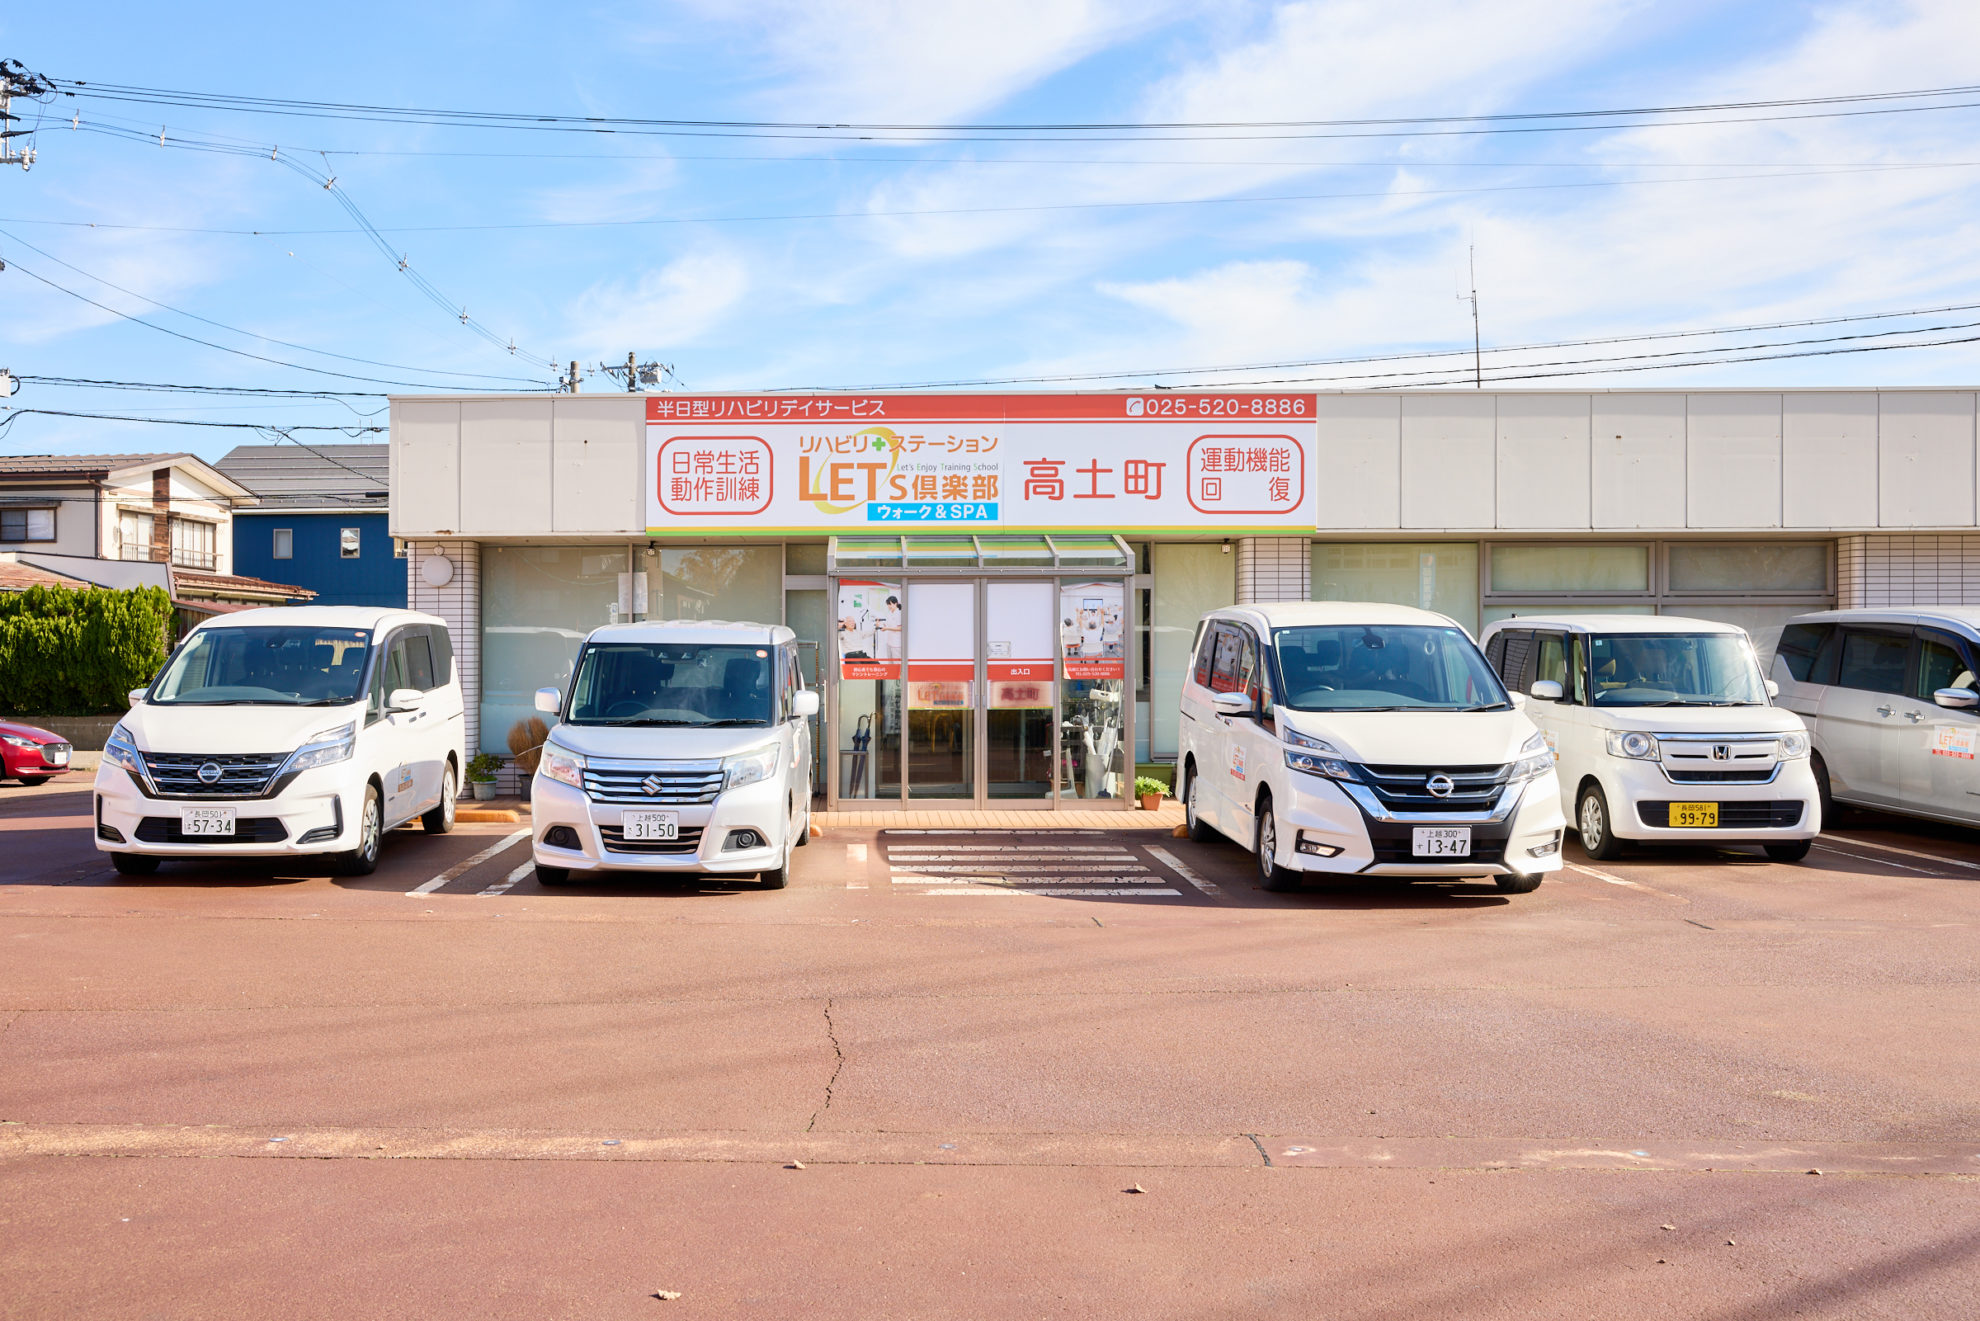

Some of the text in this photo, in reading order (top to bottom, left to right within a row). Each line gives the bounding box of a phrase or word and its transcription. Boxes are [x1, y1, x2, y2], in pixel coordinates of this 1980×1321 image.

[657, 399, 886, 418] 半日型リハビリデイサービス
[1146, 398, 1306, 416] 025-520-8886
[672, 449, 760, 475] 日常生活
[896, 463, 999, 472] Let's Enjoy Training School
[1200, 447, 1291, 473] 運動機能
[671, 476, 760, 502] 動作訓練
[1023, 457, 1167, 501] 高土町
[1010, 668, 1031, 676] 出入口
